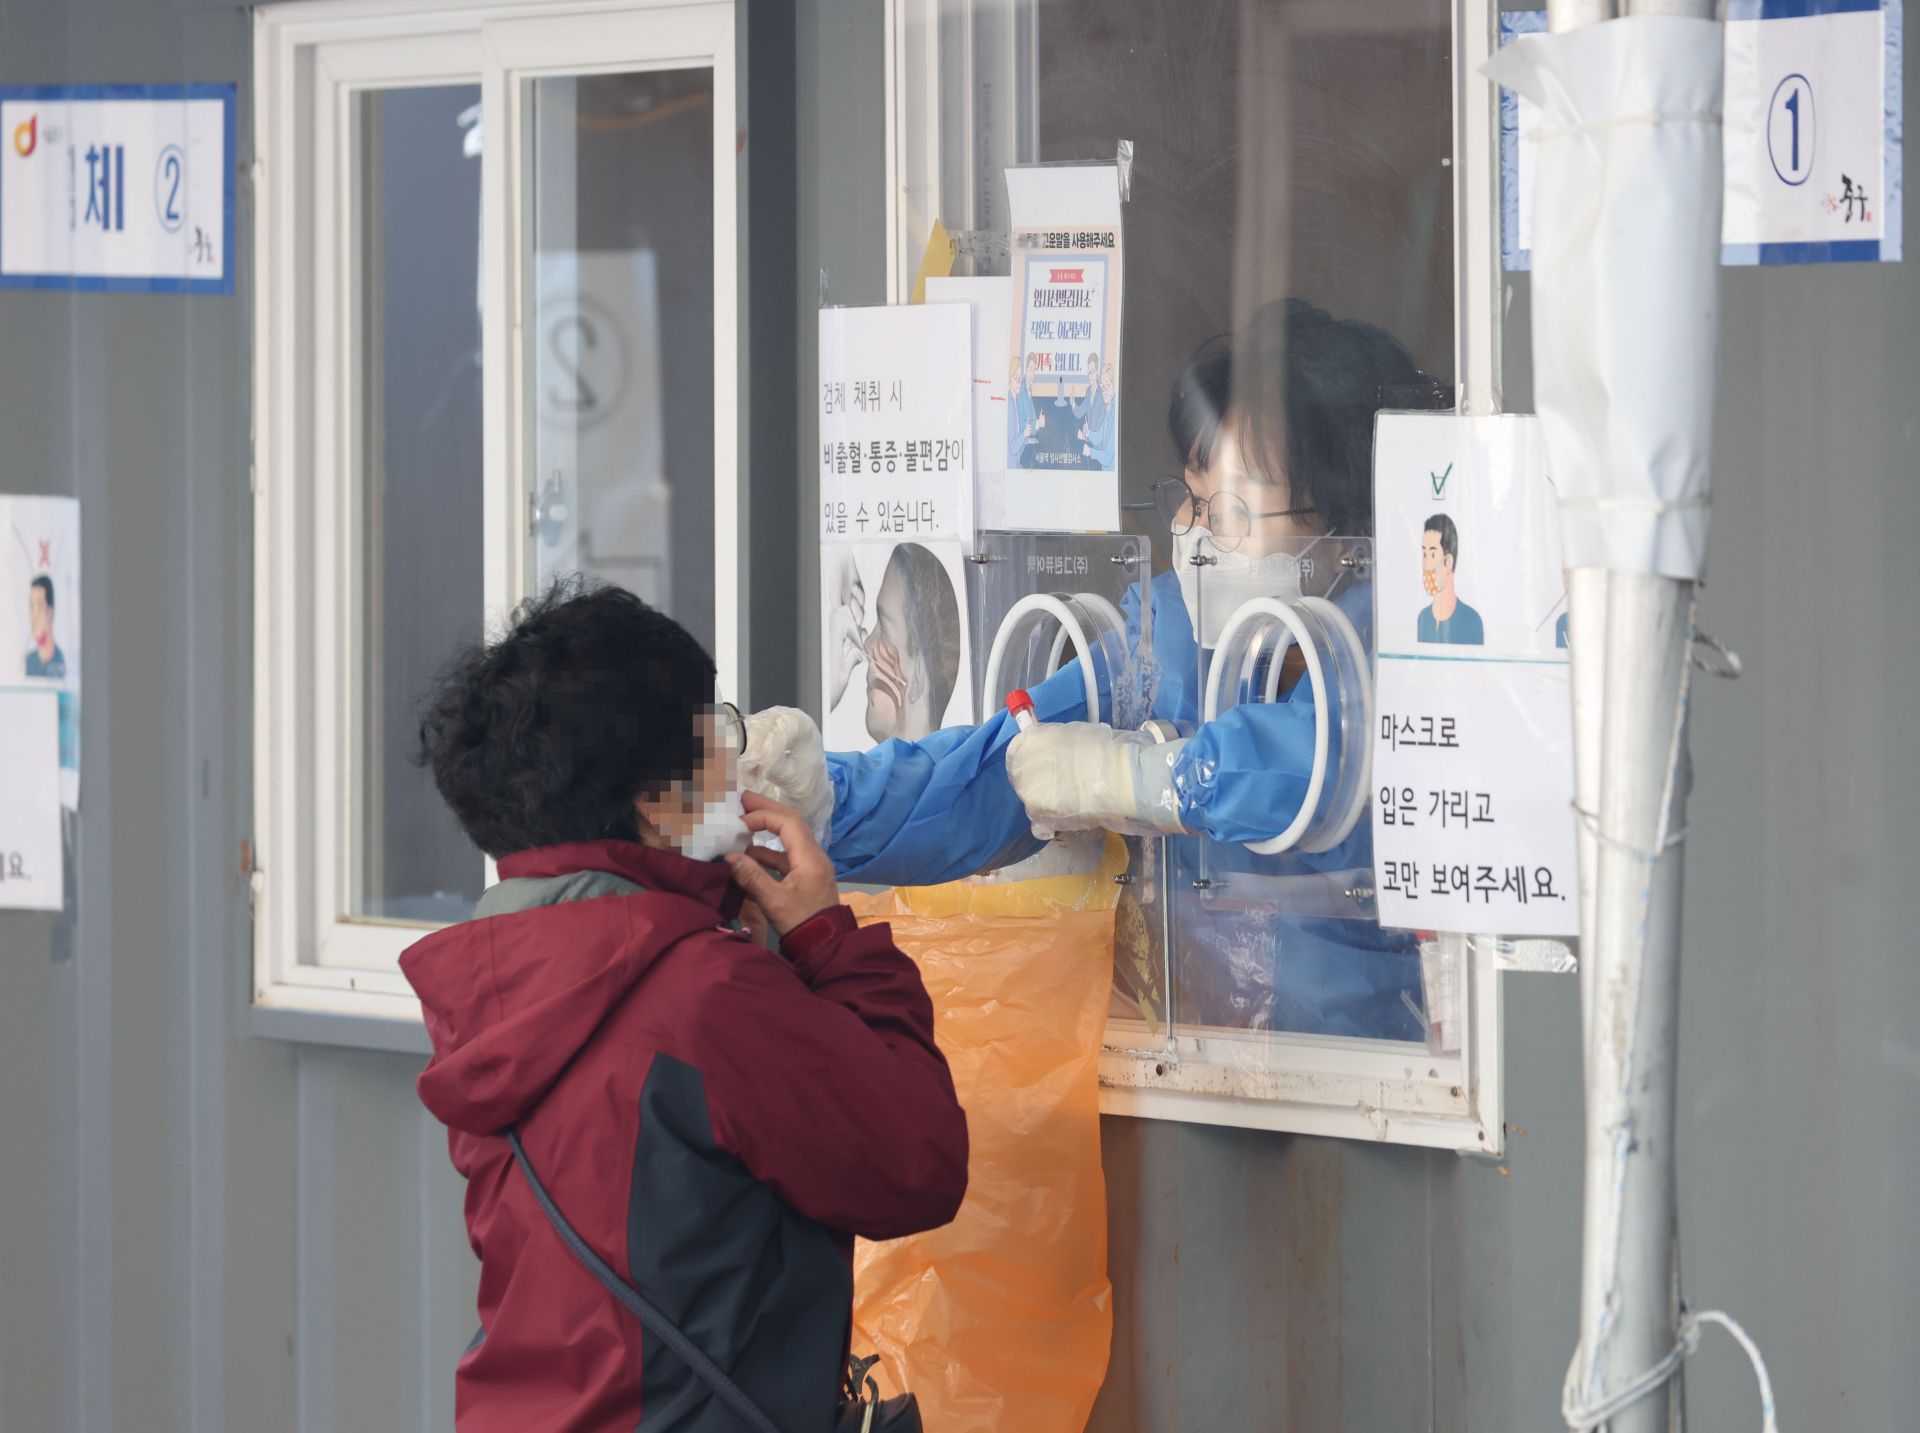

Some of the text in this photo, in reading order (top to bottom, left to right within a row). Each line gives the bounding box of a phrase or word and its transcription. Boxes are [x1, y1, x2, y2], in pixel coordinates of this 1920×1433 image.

[67, 144, 124, 231] 체
[1072, 232, 1115, 249] 사용해주세요
[1034, 288, 1092, 308] 임시선별검사소
[1031, 320, 1055, 340] 직원도
[1036, 352, 1082, 372] 가족 입니다.
[824, 379, 902, 414] 검체 채취 시
[825, 500, 939, 534] 있을 수 있습니다.
[1382, 714, 1459, 752] 마스크로
[1380, 786, 1495, 829] 입은 가리고
[1383, 861, 1566, 904] 코만 보여주세요.
